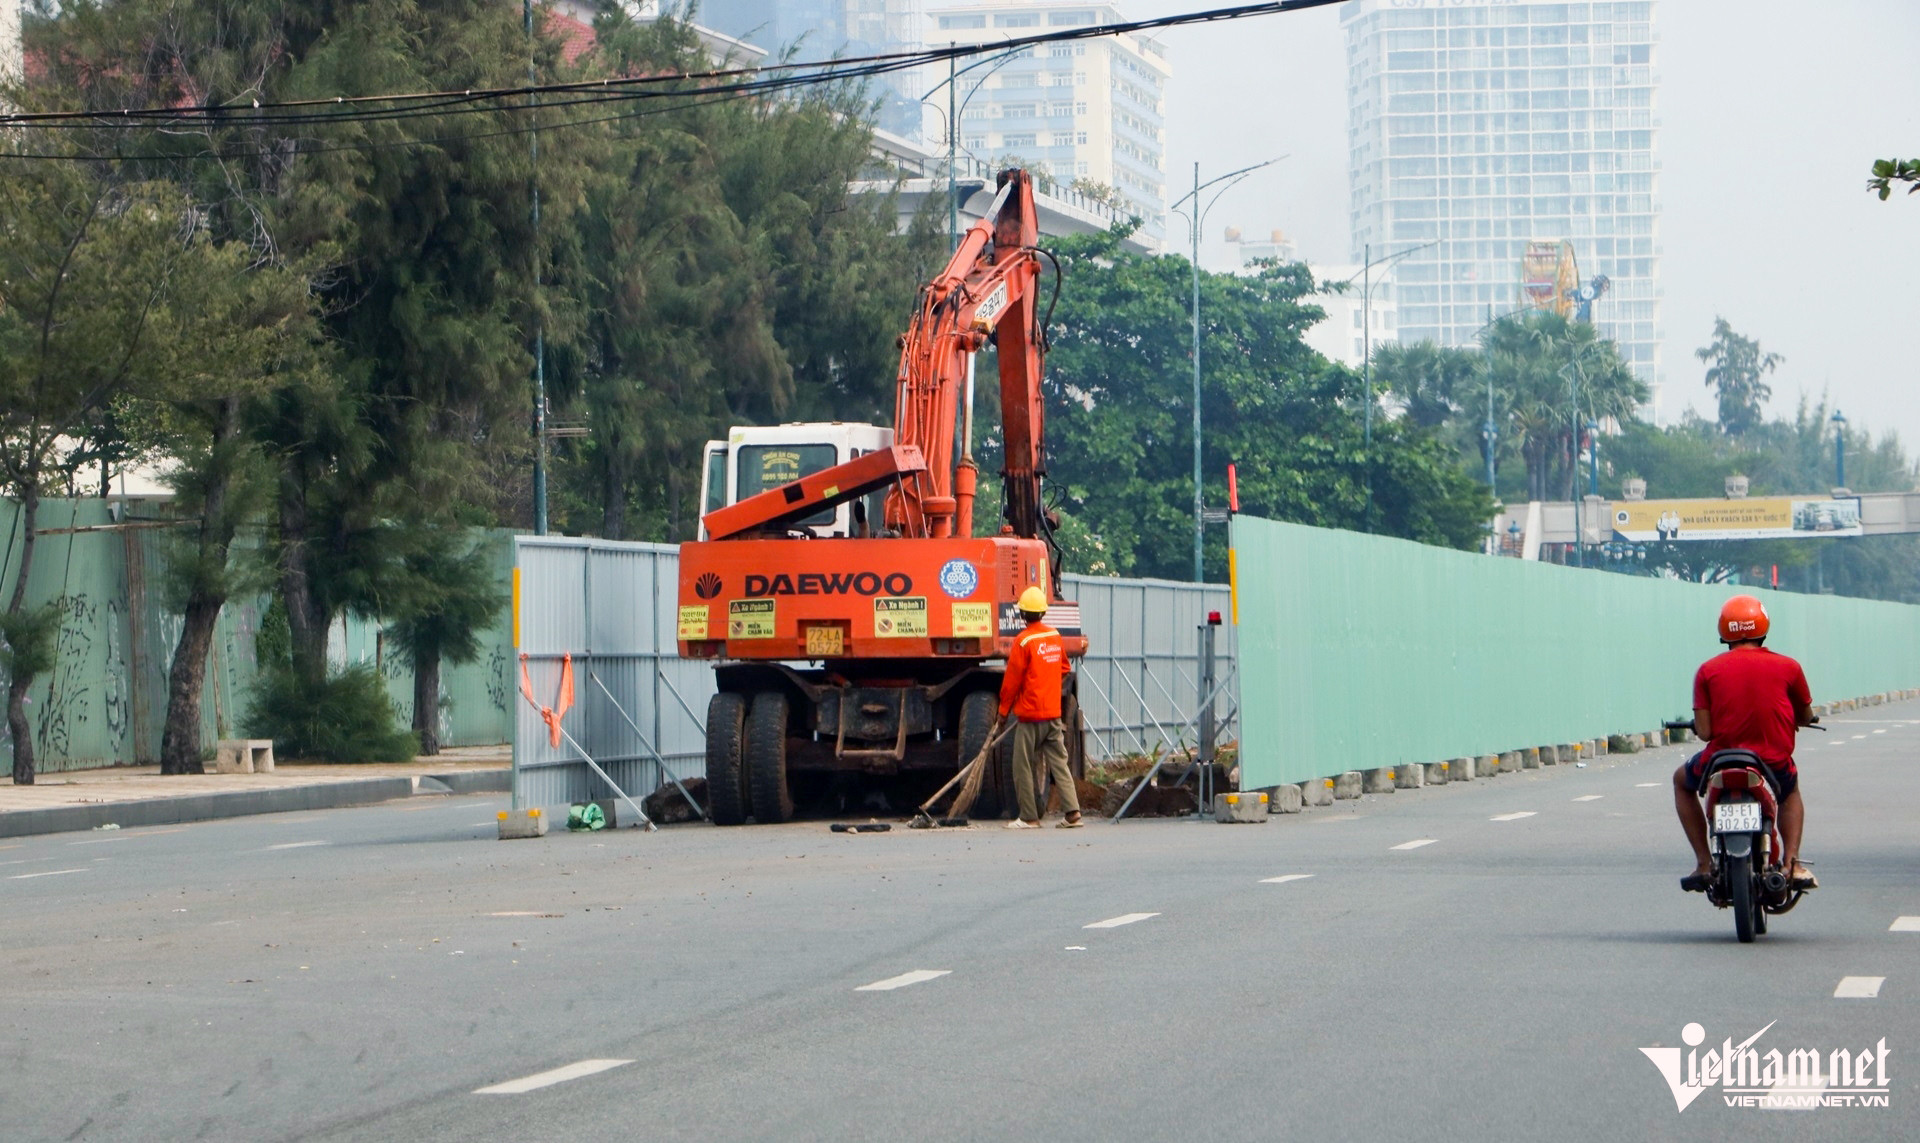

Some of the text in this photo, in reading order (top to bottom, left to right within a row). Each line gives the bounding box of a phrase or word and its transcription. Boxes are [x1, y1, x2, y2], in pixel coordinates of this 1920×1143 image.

[745, 571, 913, 597] DAEWOO
[889, 601, 897, 609] Xe
[810, 641, 840, 654] 0572
[1720, 804, 1752, 817] 59-E1
[1717, 818, 1758, 831] 302.62
